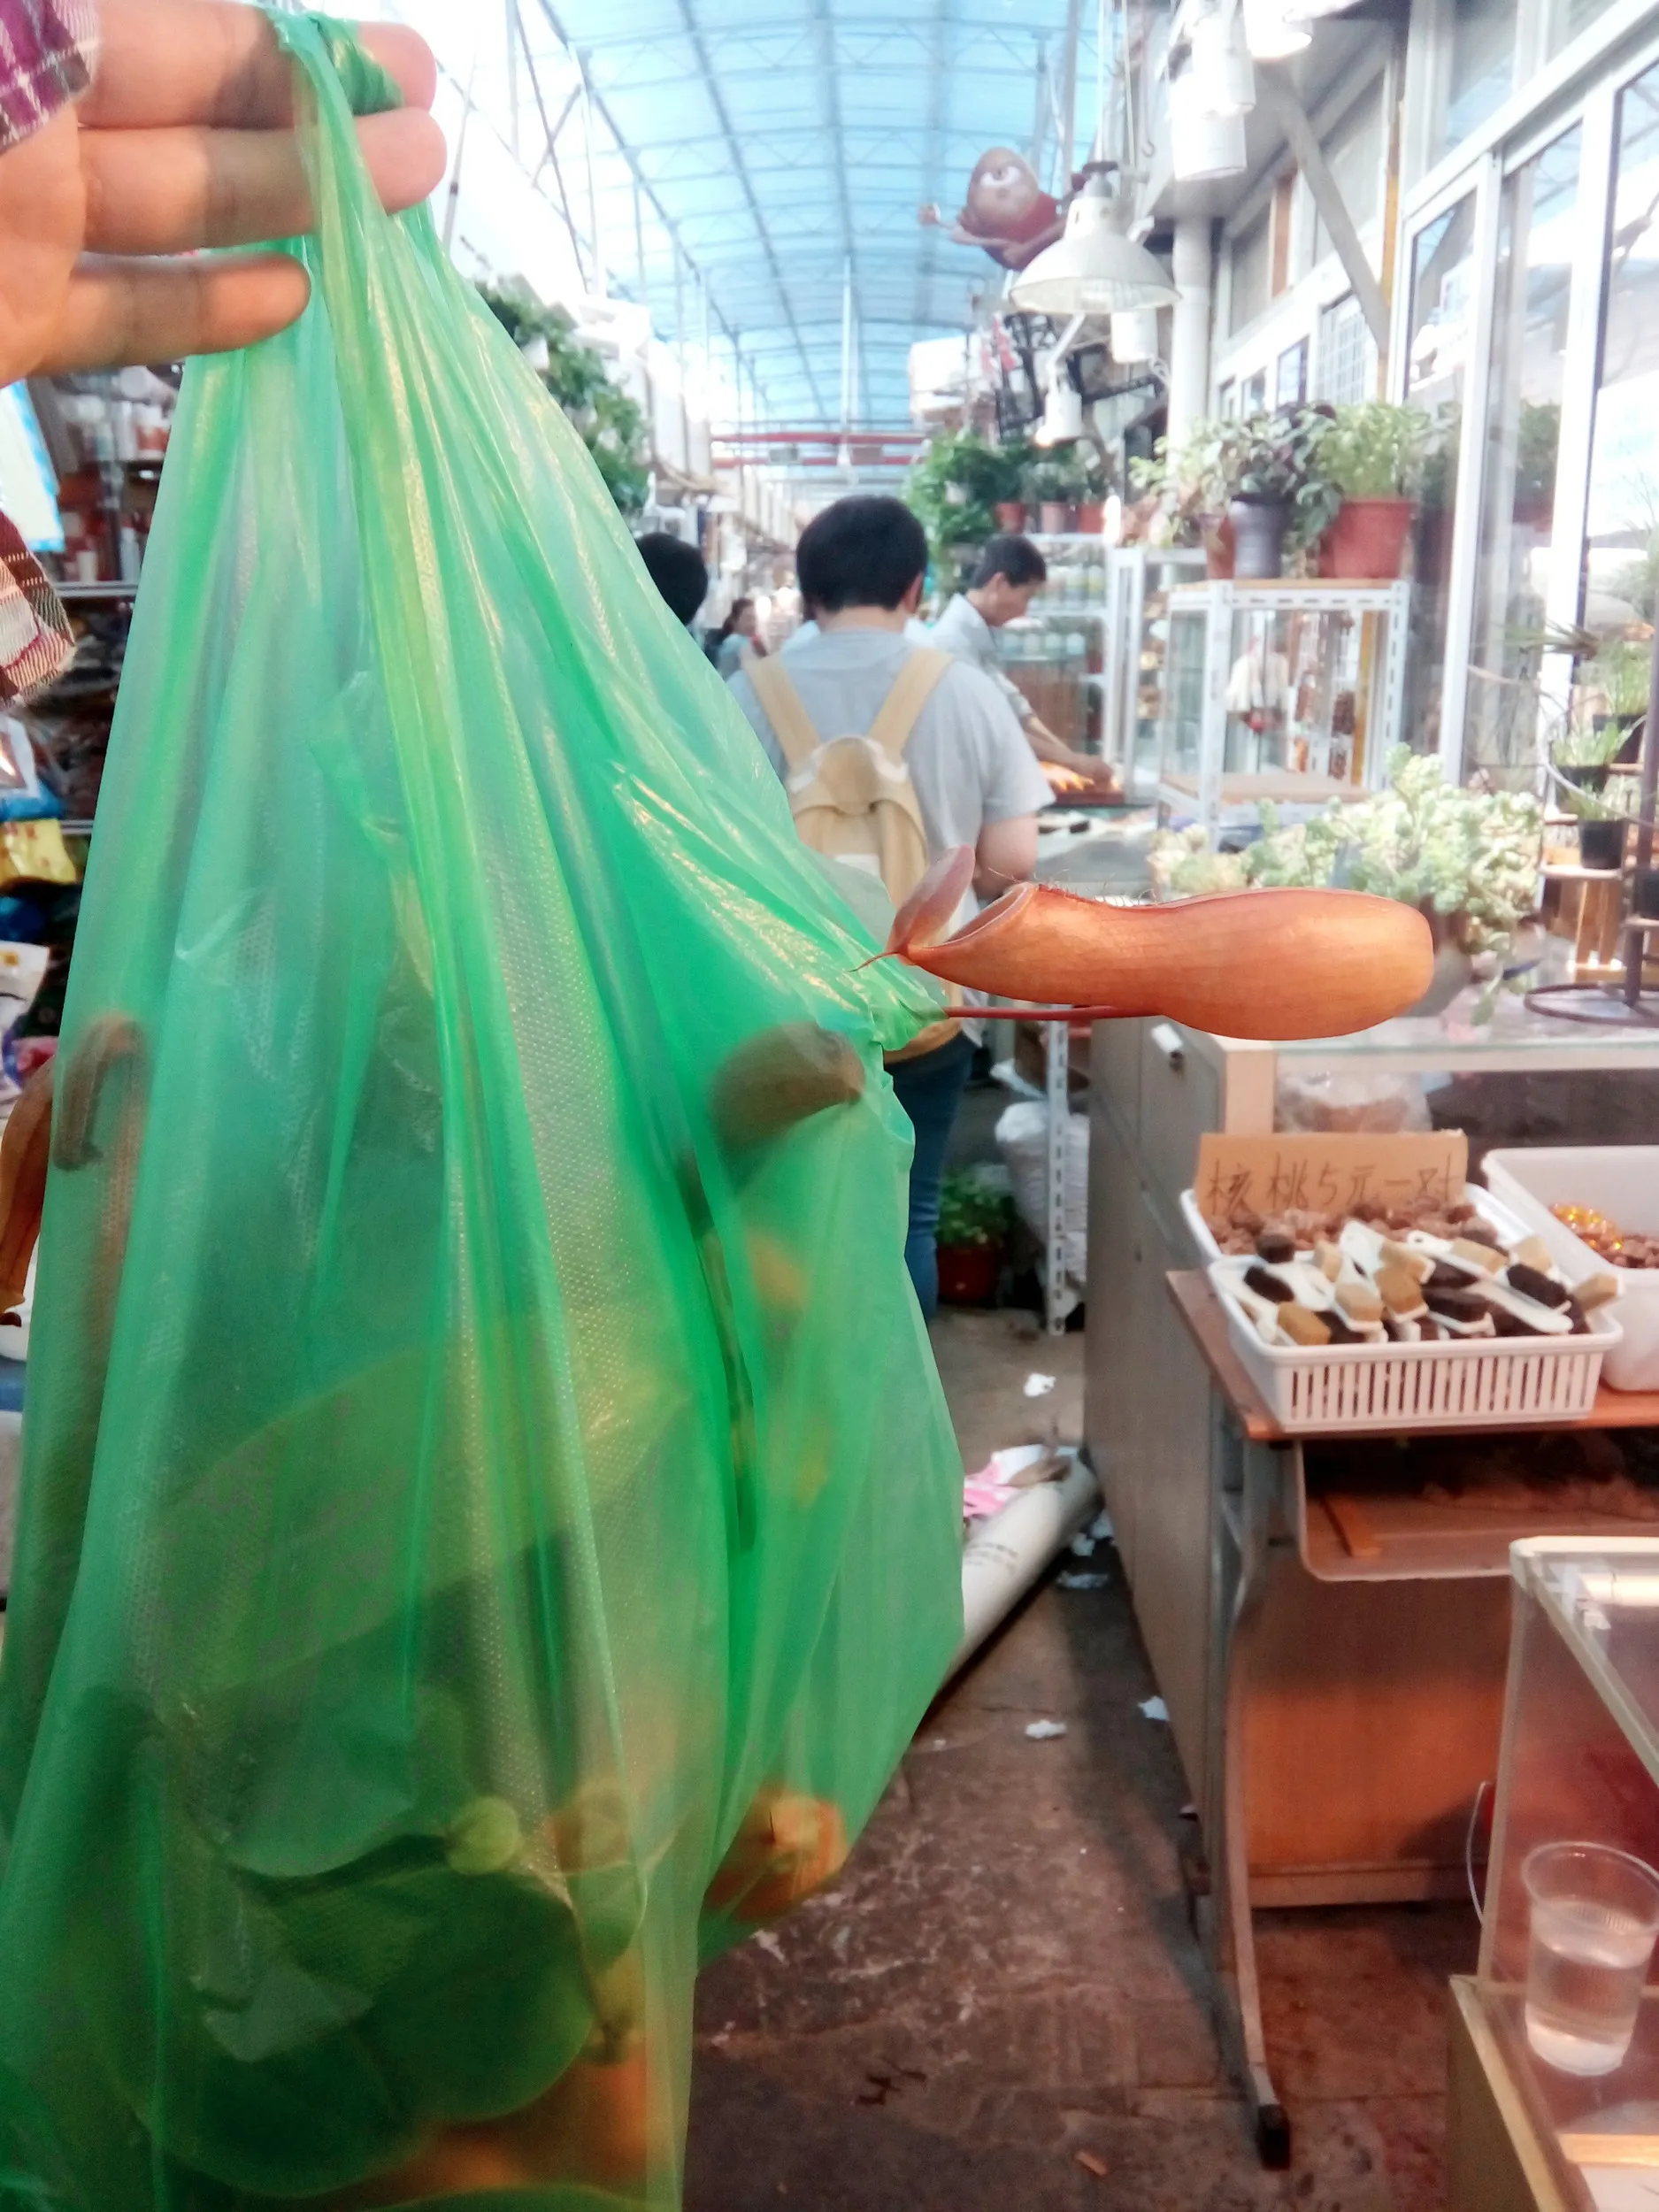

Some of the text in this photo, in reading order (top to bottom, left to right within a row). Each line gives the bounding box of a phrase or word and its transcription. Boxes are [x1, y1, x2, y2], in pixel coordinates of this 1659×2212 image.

[1207, 1152, 1459, 1216] 核桃5元一对
